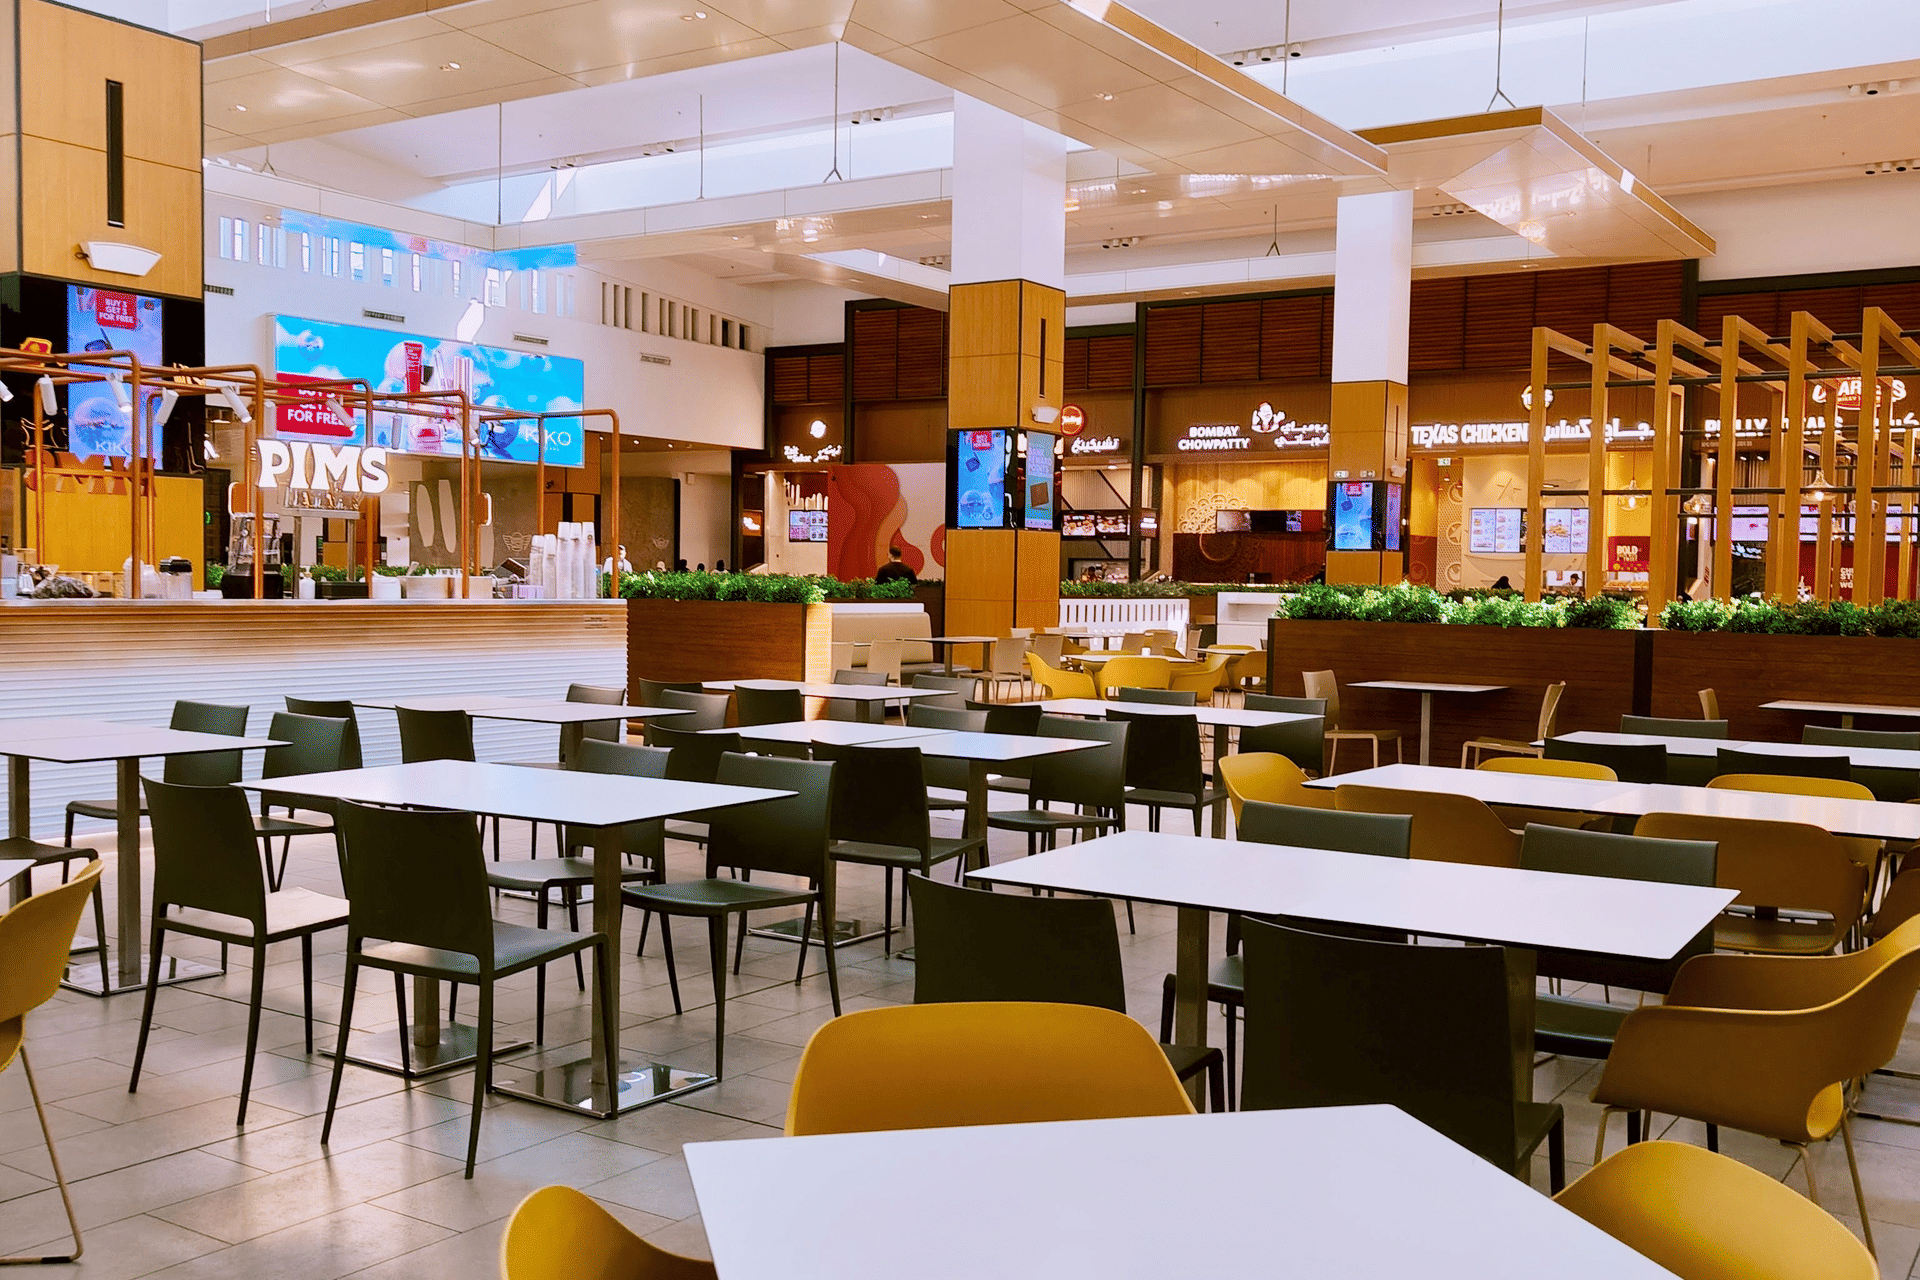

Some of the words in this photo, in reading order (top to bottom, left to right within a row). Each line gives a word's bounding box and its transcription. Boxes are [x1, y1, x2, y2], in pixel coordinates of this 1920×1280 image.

[99, 312, 115, 320] FOR
[116, 315, 134, 324] FREE
[287, 408, 314, 422] FOR
[524, 428, 572, 447] KKO
[1189, 425, 1240, 438] BOMBAY
[1410, 423, 1459, 448] TEXAS
[1460, 422, 1530, 443] CHICKEN
[1178, 438, 1250, 451] CHOWPATTY
[257, 440, 389, 493] PIMS
[1616, 545, 1639, 555] BOLD
